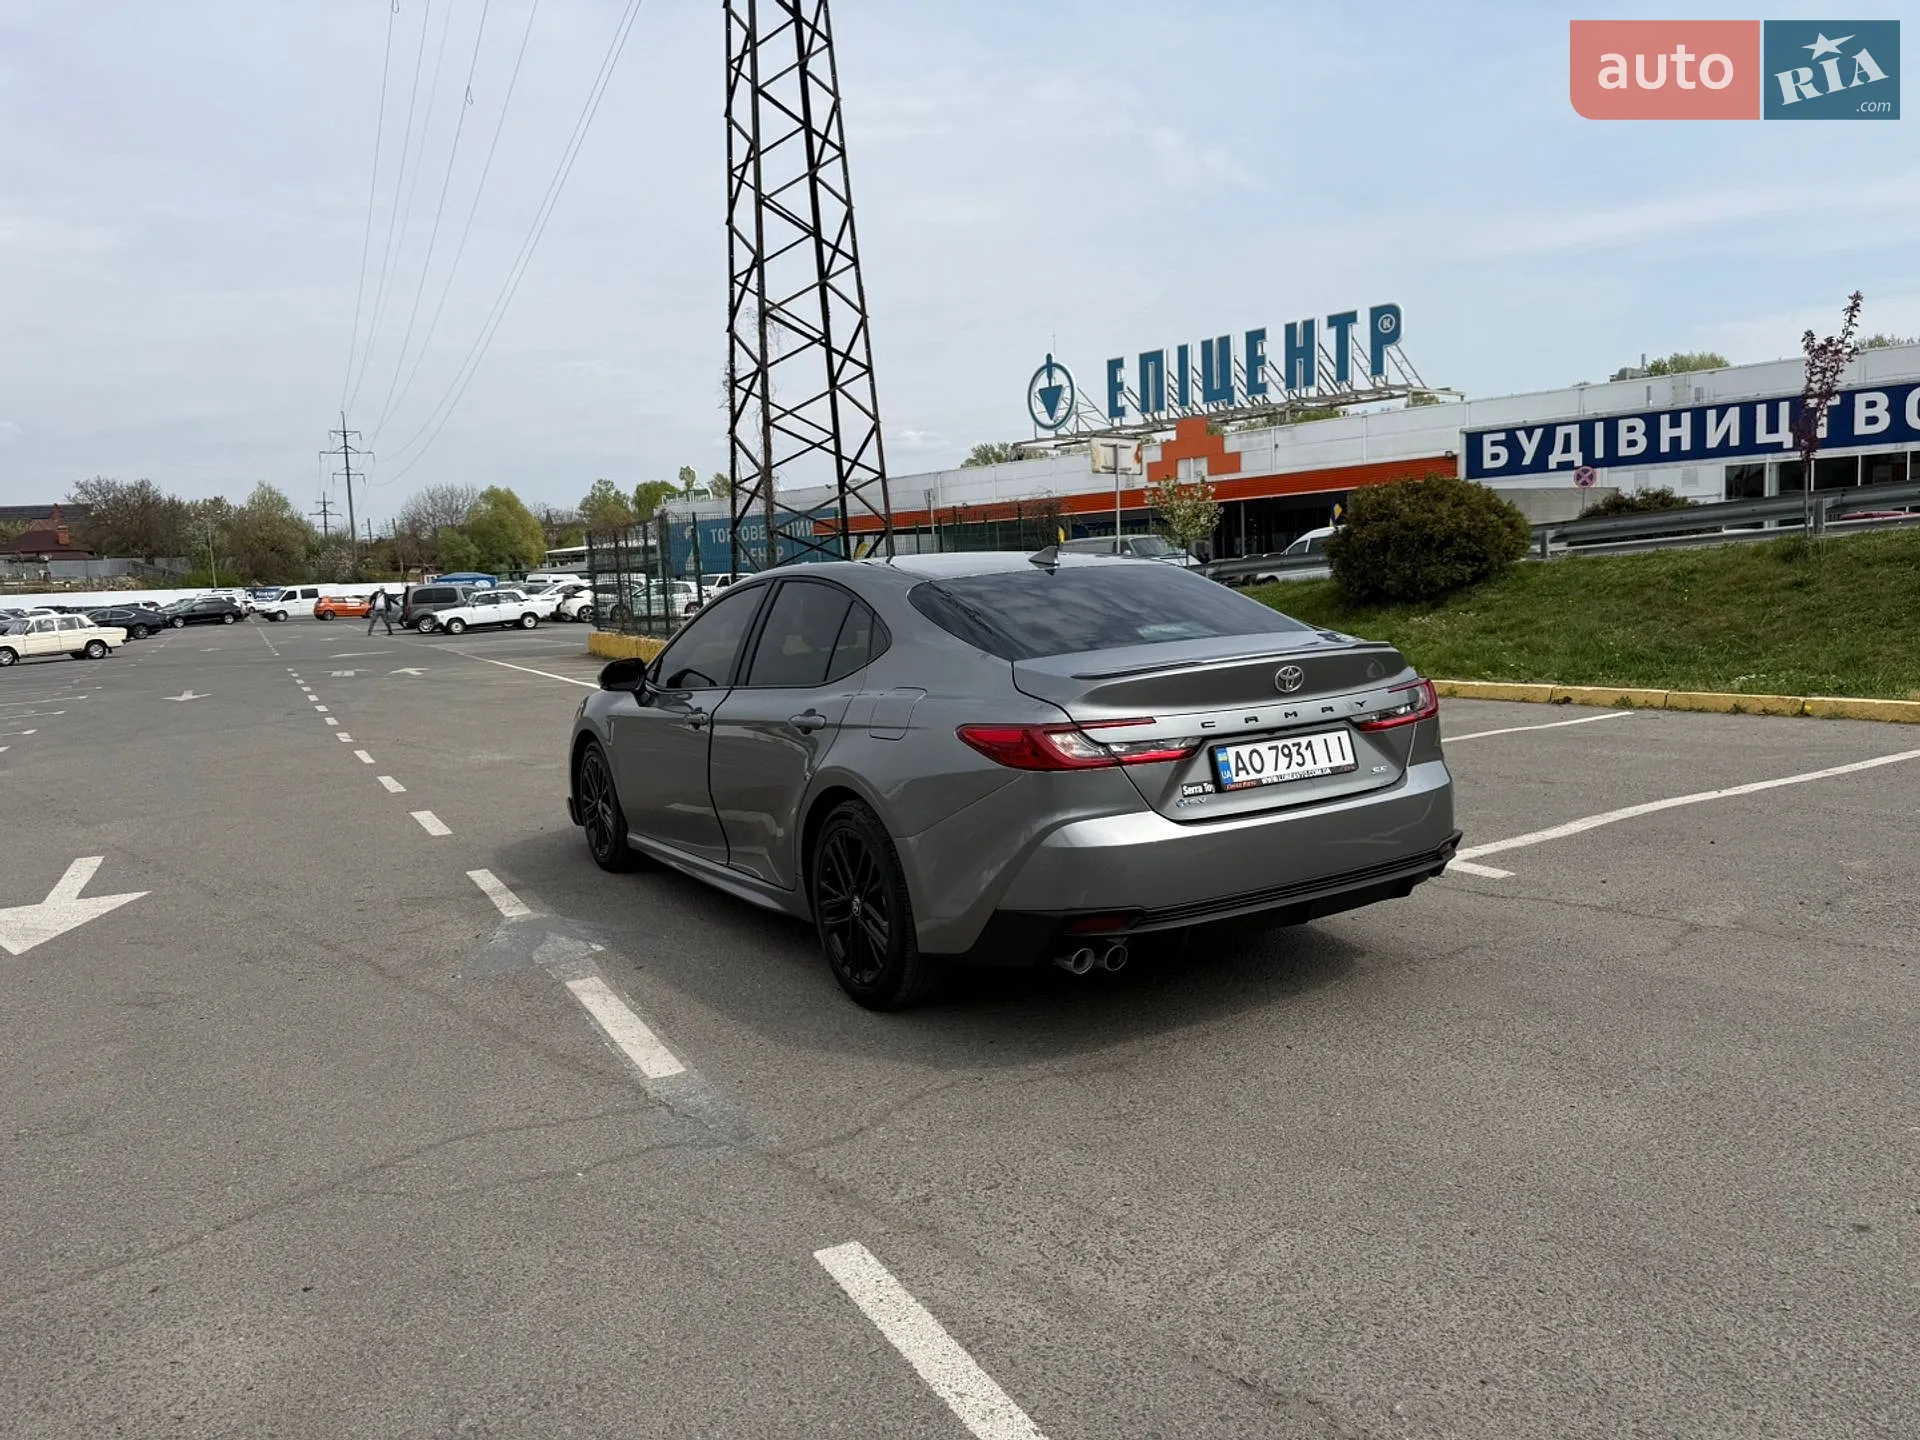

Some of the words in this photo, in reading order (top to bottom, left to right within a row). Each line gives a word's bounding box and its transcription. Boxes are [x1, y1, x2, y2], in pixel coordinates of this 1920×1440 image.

[1106, 301, 1404, 419] ЕПІЦЕНТР
[1201, 700, 1367, 728] CAMRY
[1235, 748, 1265, 777] AO
[1268, 740, 1318, 772] 7931
